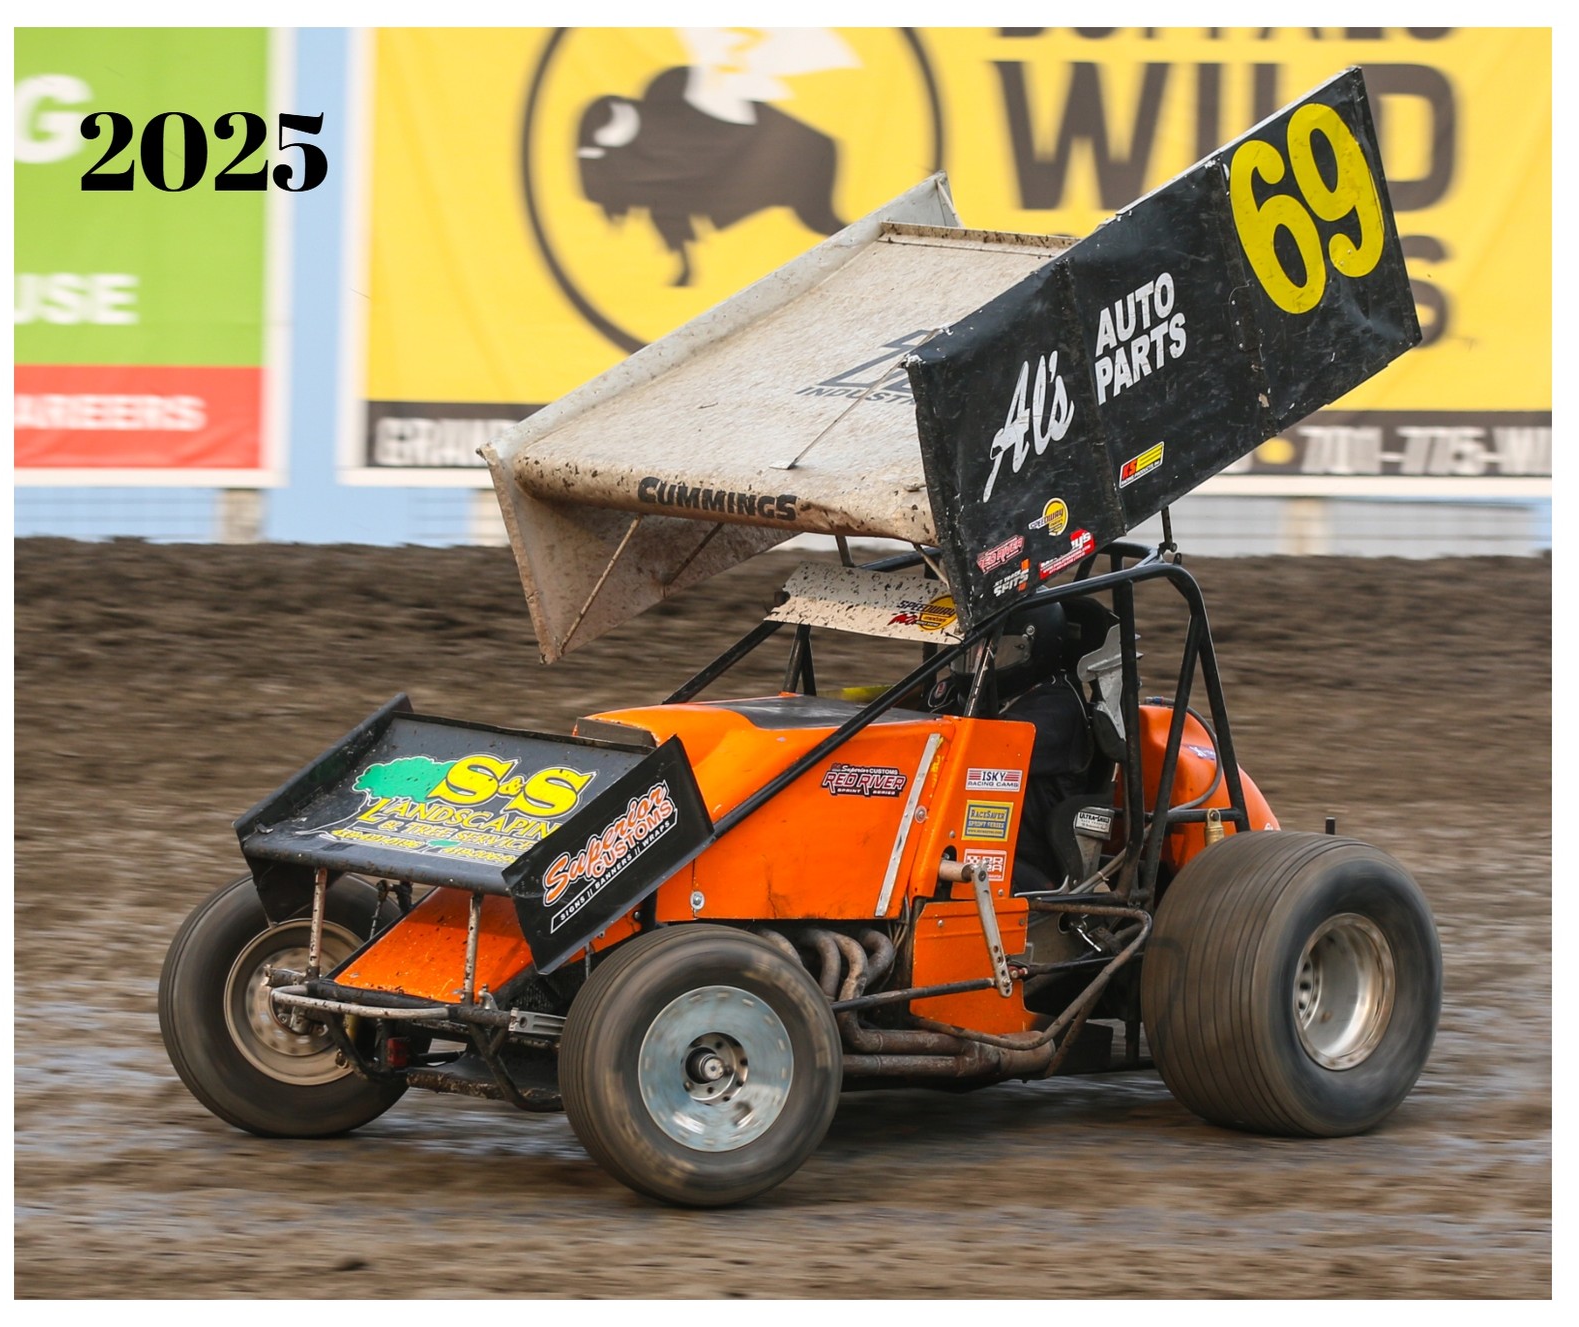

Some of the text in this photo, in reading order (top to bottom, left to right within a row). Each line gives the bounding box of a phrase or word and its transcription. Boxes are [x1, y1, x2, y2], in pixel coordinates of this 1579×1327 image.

[1229, 102, 1386, 314] 69
[1095, 272, 1175, 357] AUTO
[1094, 312, 1187, 406] PARTS
[983, 350, 1075, 503] Al's
[638, 476, 798, 521] CUMMINGS
[897, 600, 957, 616] SPEEDWAY
[426, 753, 596, 818] S&S
[822, 771, 907, 796] RED RIVER
[869, 768, 898, 776] CUSTOMS
[982, 771, 1006, 782] ISKY
[404, 822, 454, 839] TREE
[544, 786, 667, 904] Superior
[592, 800, 674, 878] CUSTOMS
[560, 896, 586, 921] SIGNS
[595, 854, 633, 890] BANNERS
[642, 820, 671, 847] WRAPS
